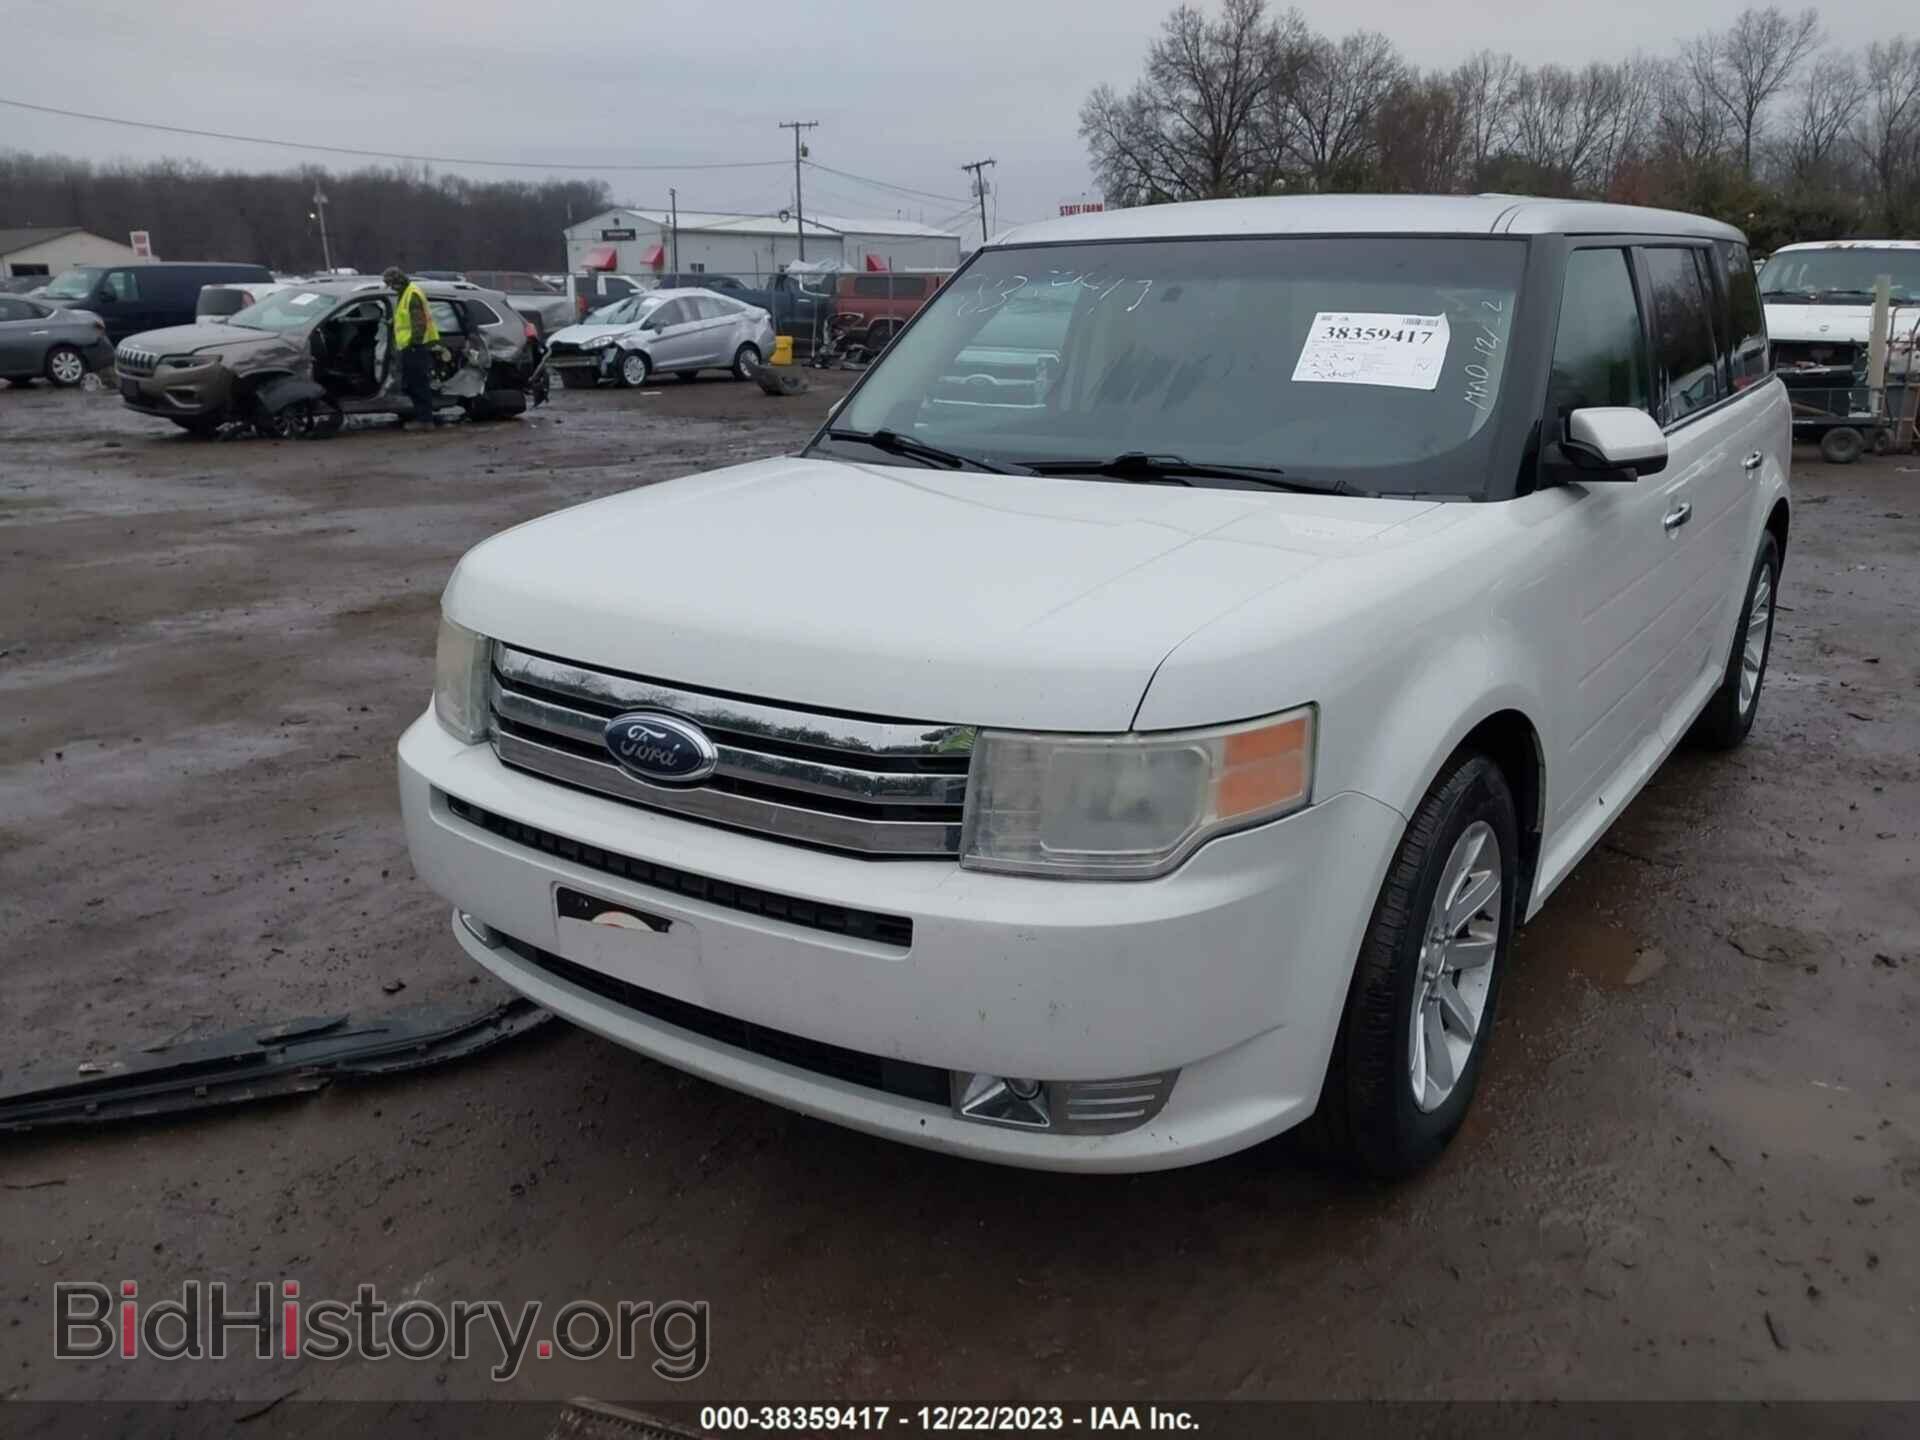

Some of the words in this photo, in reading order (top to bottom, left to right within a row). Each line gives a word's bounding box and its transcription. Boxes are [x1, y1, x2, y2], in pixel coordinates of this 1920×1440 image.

[1060, 205, 1080, 216] STATE
[1082, 203, 1103, 213] FARM
[1321, 326, 1433, 345] 38359417
[620, 724, 681, 766] Ford
